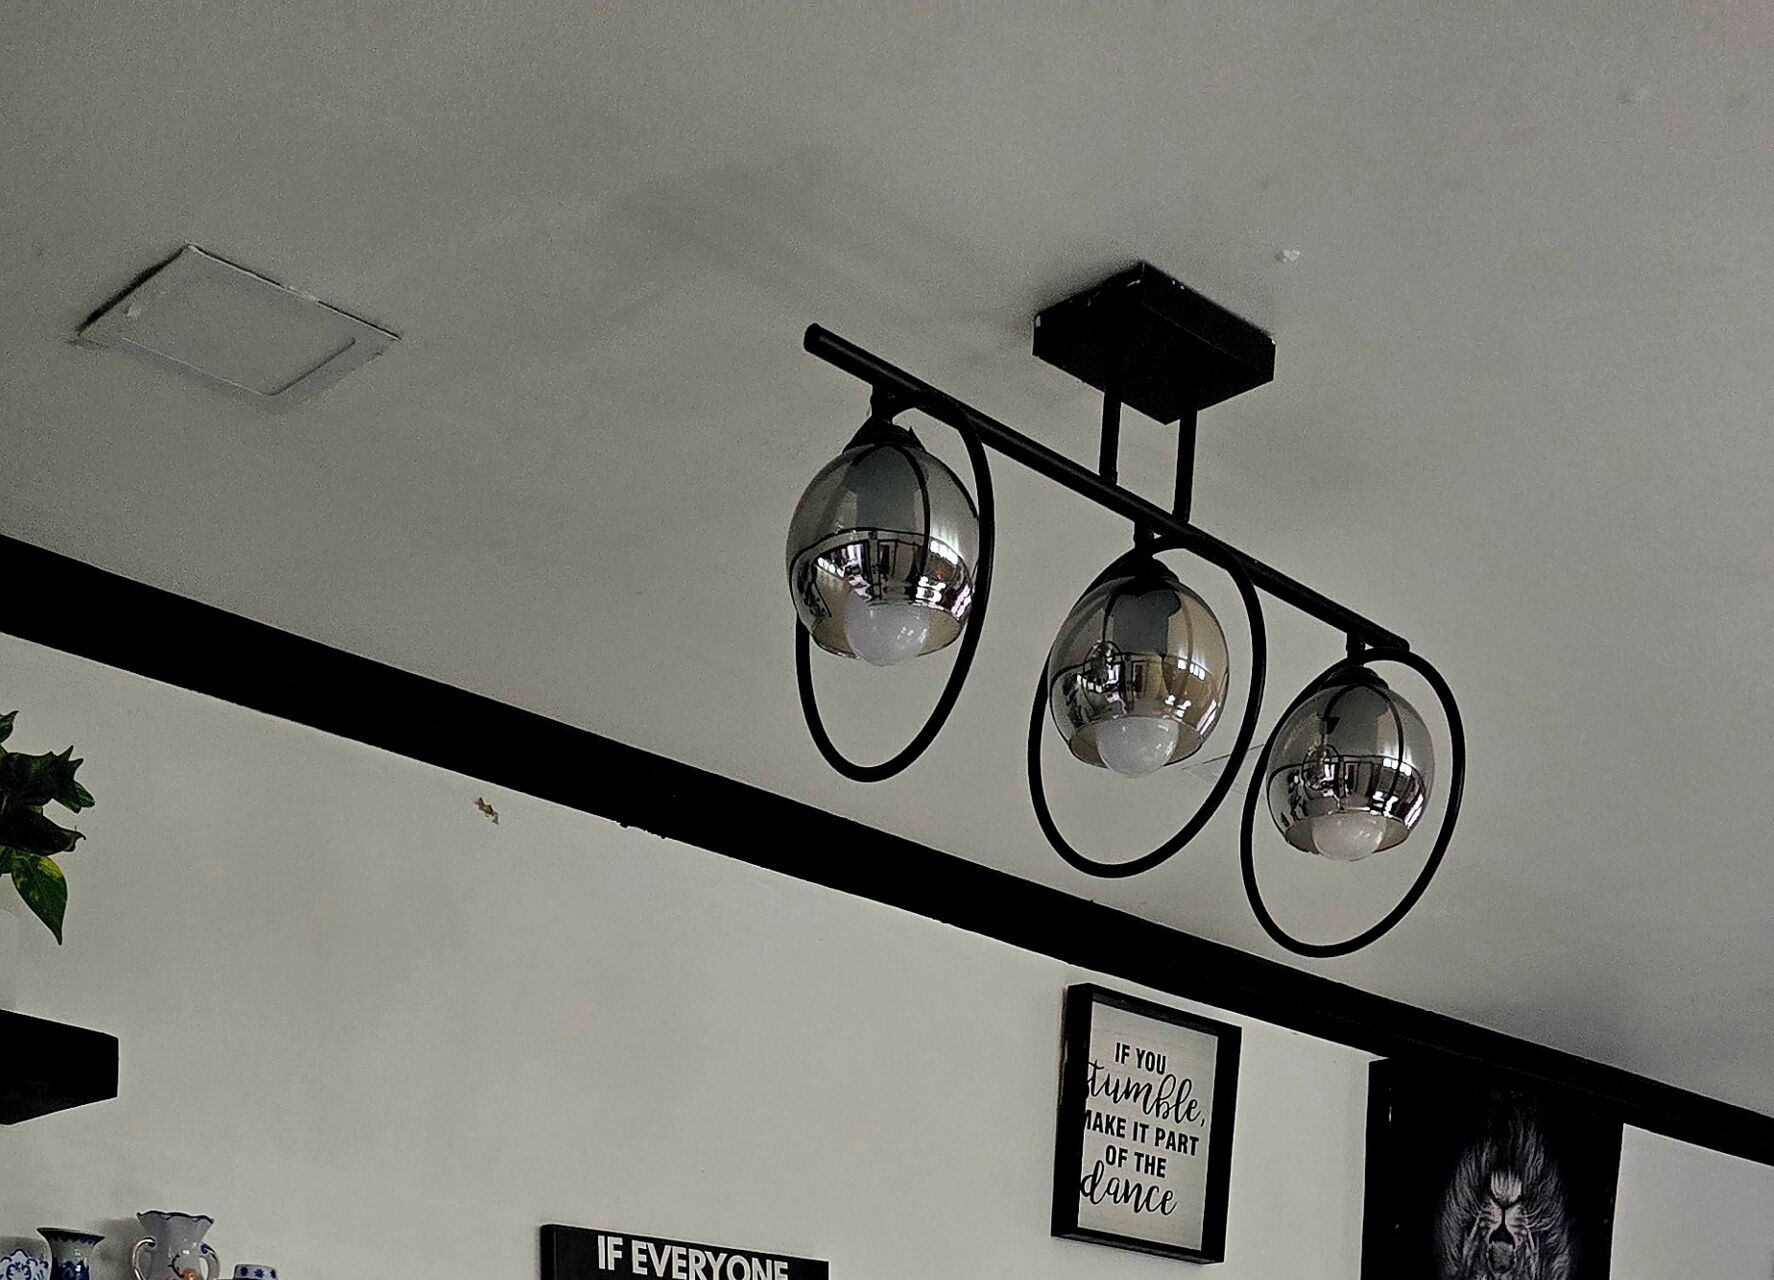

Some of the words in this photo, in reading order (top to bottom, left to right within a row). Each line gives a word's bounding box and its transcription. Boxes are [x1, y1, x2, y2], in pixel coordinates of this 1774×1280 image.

[1114, 1042, 1130, 1065] IF
[1136, 1048, 1167, 1075] YOU
[1087, 1059, 1206, 1127] tumble,
[1133, 1121, 1150, 1144] IT
[1154, 1127, 1200, 1156] PART
[1106, 1145, 1128, 1168] OF
[1134, 1151, 1167, 1178] THE
[1080, 1160, 1177, 1216] dance
[597, 1235, 623, 1271] IF
